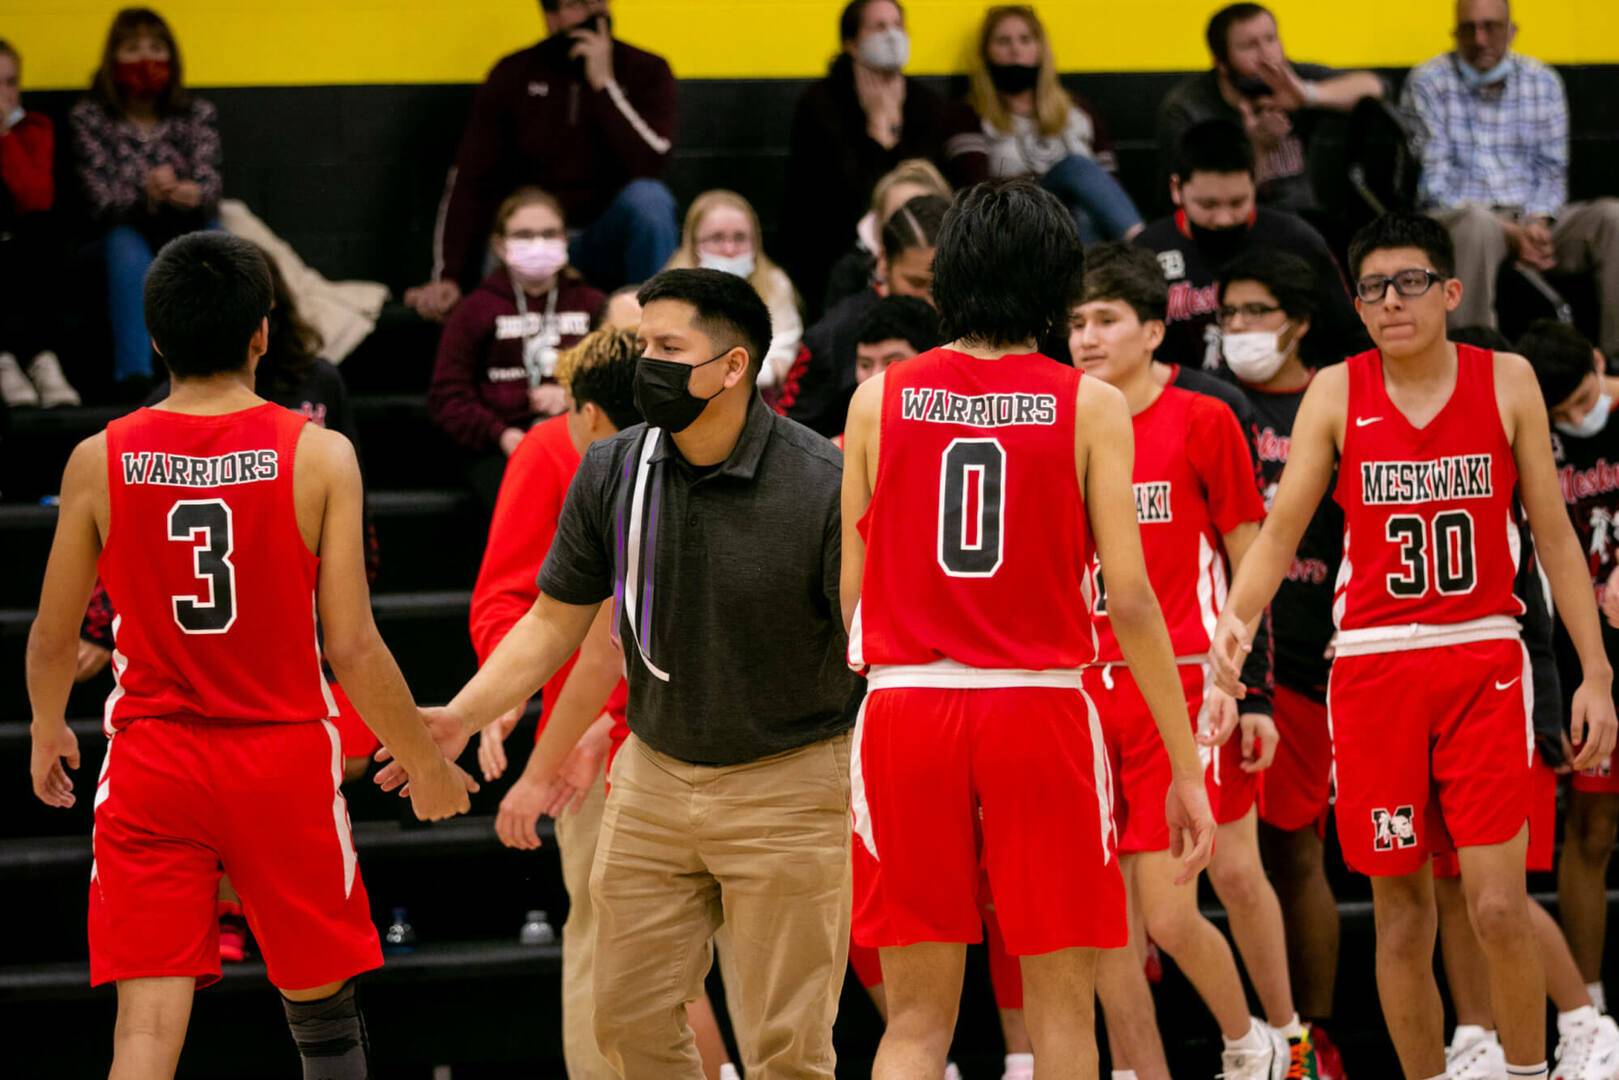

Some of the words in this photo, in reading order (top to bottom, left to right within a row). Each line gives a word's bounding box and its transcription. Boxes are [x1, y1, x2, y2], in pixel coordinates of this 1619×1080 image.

[902, 387, 1056, 428] WARRIORS
[122, 449, 278, 488] WARRIORS
[1361, 453, 1493, 505] MESKWAKI
[937, 437, 1007, 578] 0
[167, 498, 237, 635] 3
[1385, 509, 1477, 598] 30
